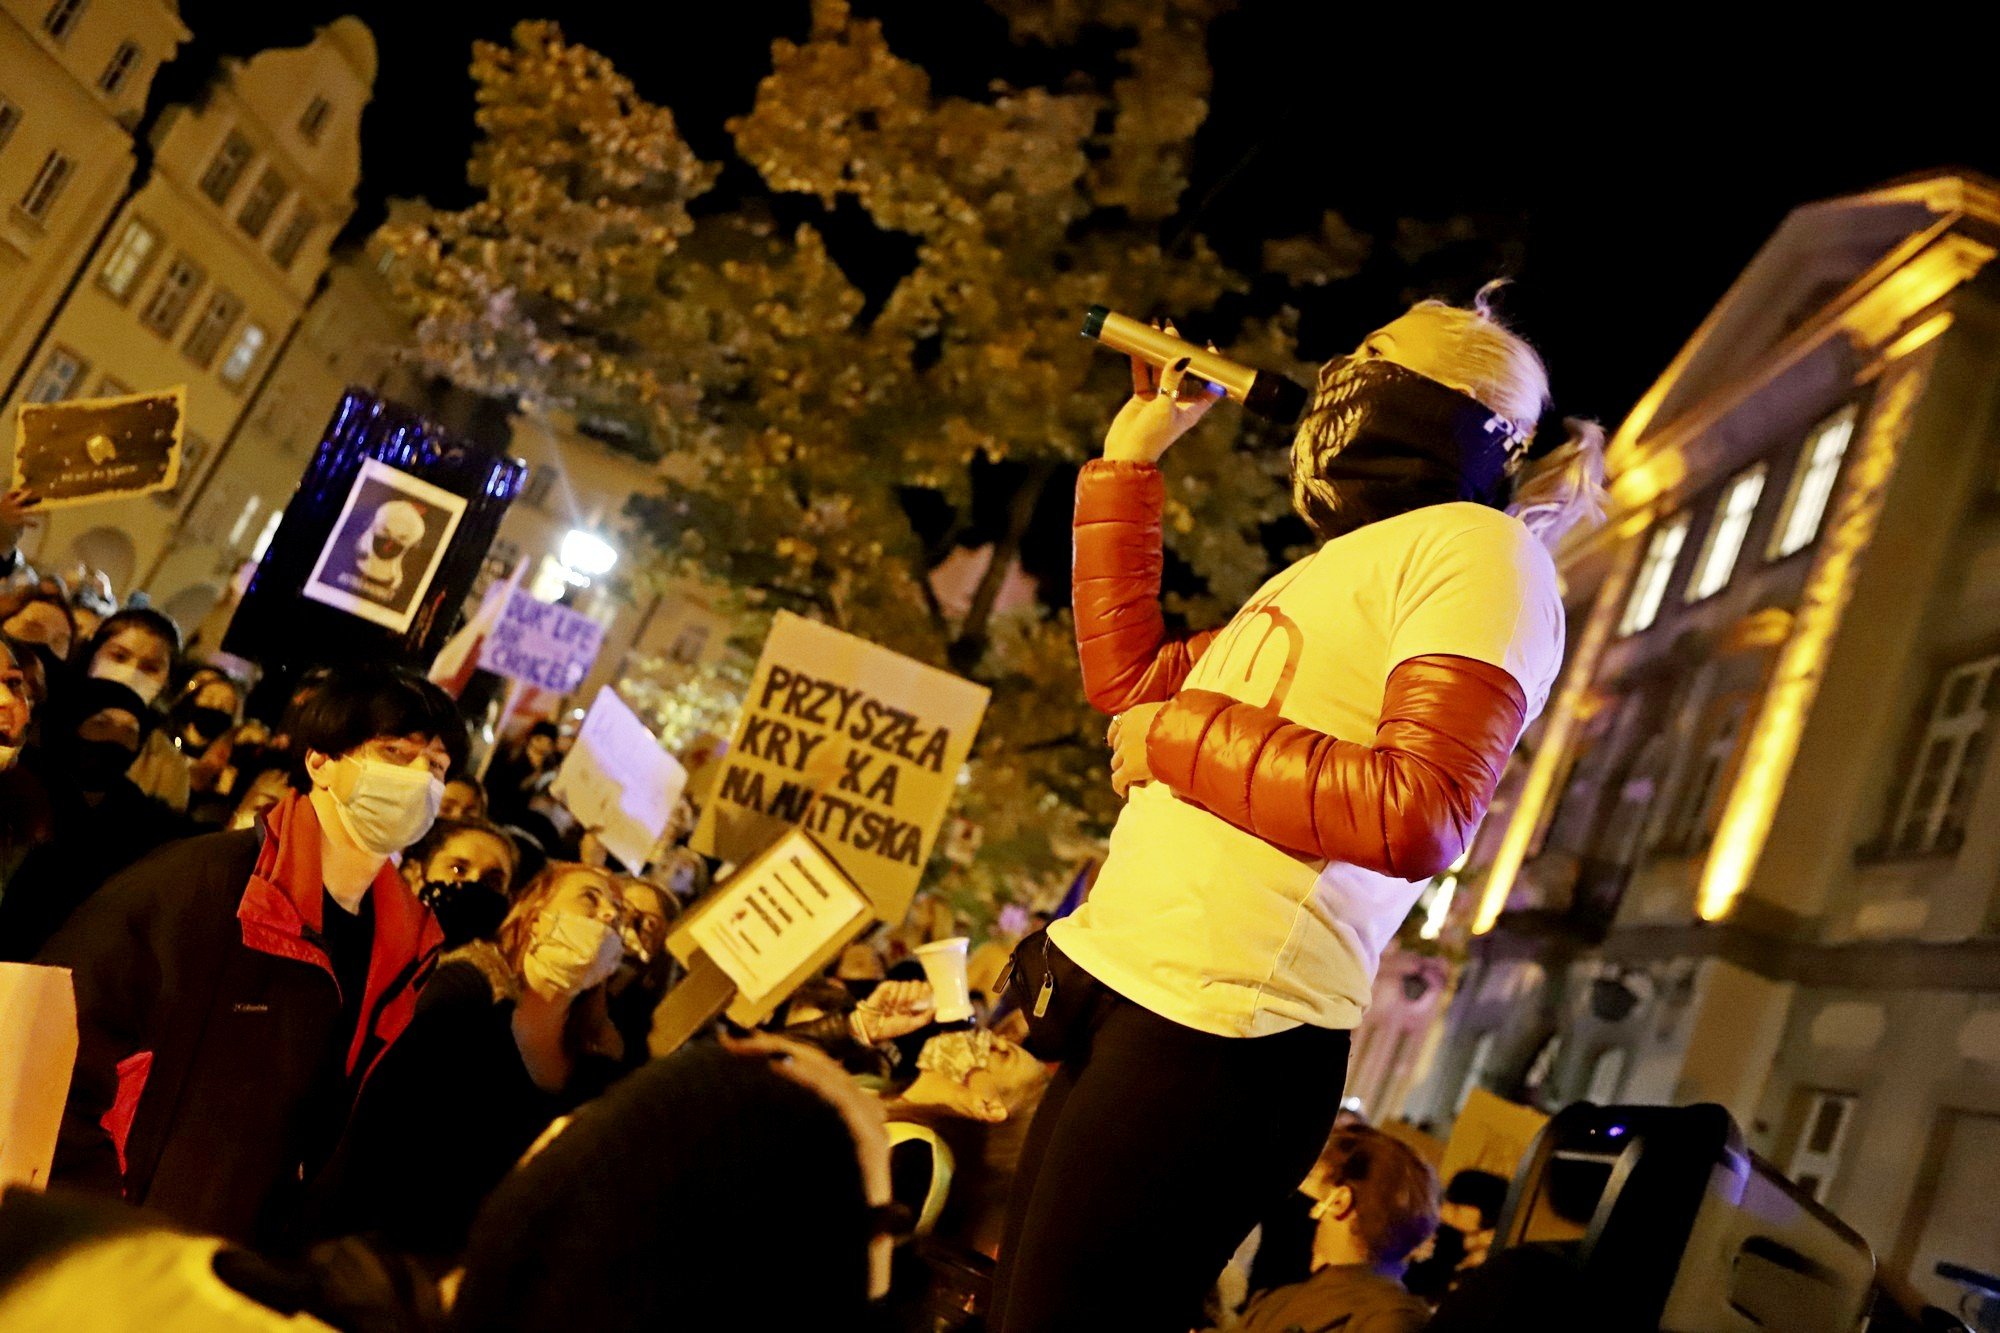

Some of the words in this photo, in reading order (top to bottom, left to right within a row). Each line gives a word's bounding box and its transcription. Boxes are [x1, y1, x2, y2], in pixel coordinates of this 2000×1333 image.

[553, 613, 597, 652] LIFE
[759, 664, 950, 773] PRZYSZŁA
[719, 765, 765, 812] NA
